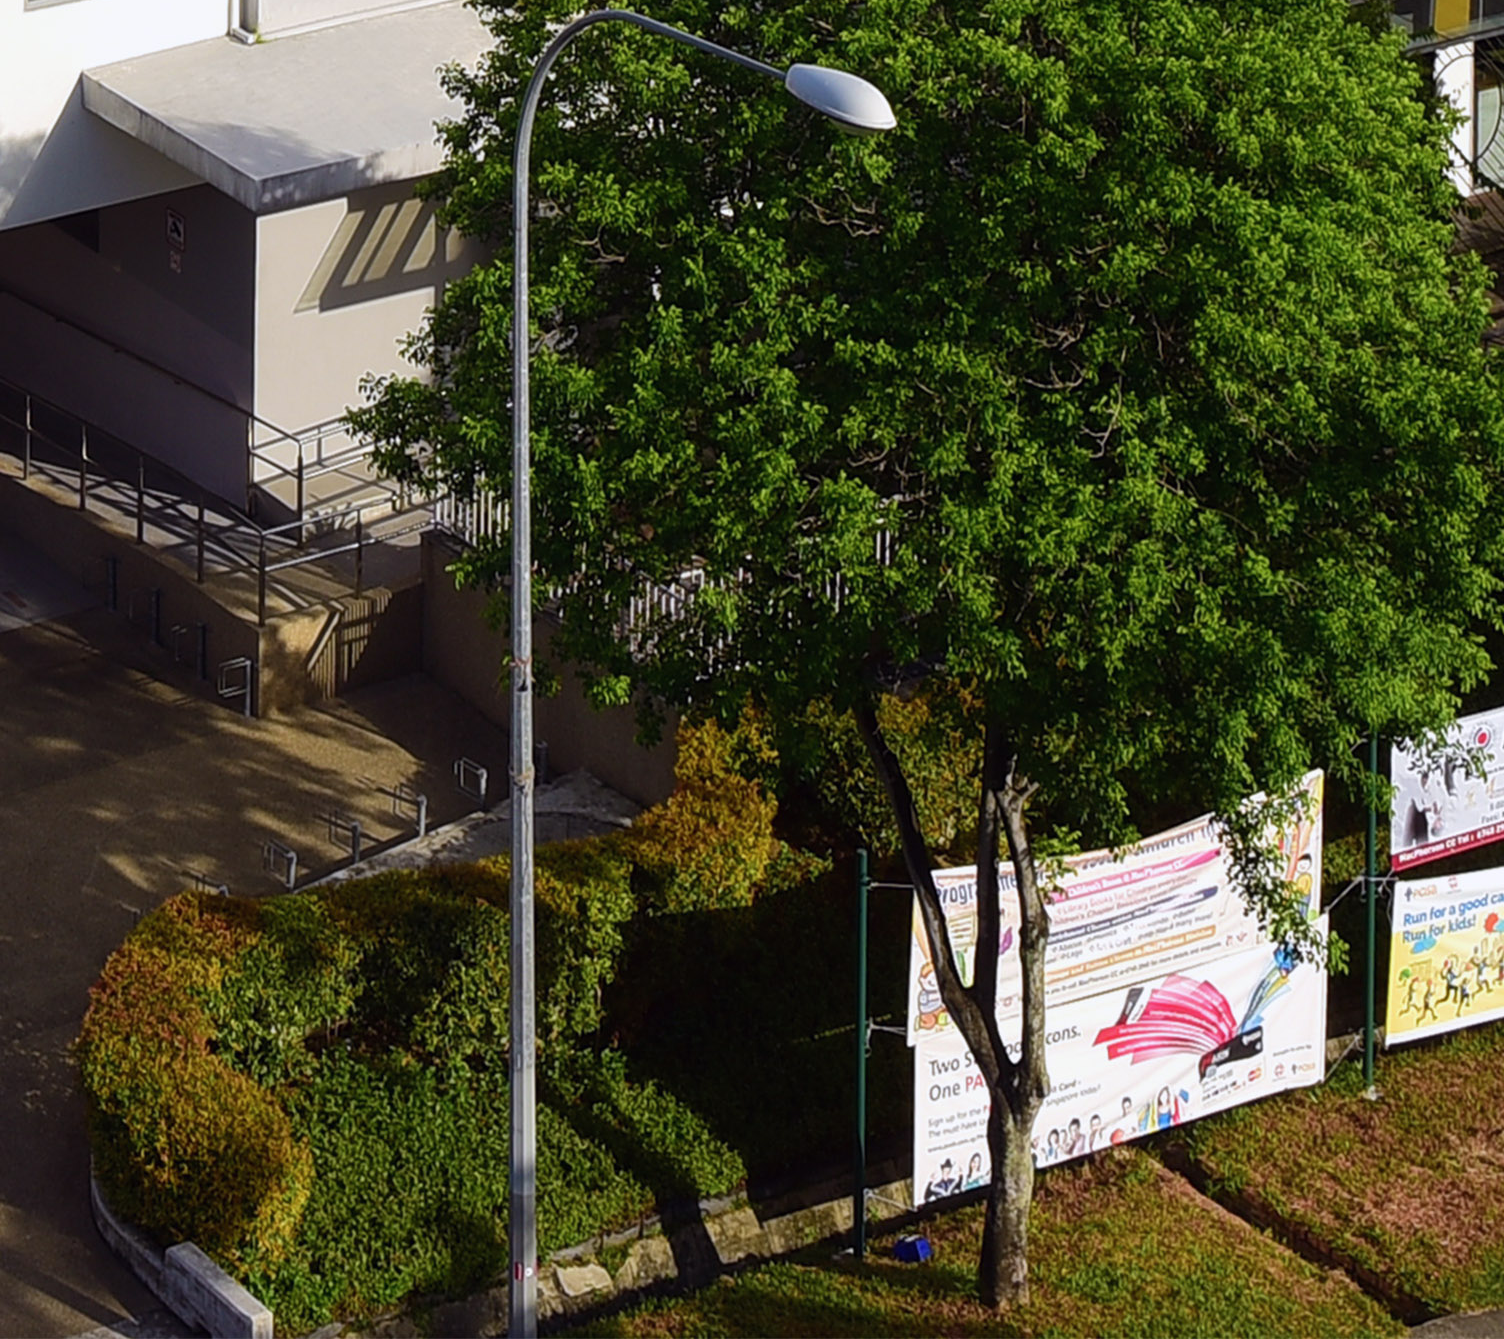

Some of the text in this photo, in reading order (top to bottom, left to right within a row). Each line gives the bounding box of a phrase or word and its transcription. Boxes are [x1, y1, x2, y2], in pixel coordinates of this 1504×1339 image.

[1398, 841, 1444, 863] MacPherson
[1445, 836, 1456, 850] CC
[1403, 911, 1427, 927] Run
[1429, 906, 1447, 921] for
[1448, 906, 1456, 915] a
[1458, 894, 1489, 916] good
[1402, 914, 1476, 944] Run for kids!
[1042, 1025, 1082, 1046] cons.
[928, 1054, 961, 1077] Two
[929, 1081, 961, 1102] One
[1059, 1078, 1077, 1092] Card
[1046, 1091, 1080, 1108] Singapore
[928, 1117, 945, 1129] Sign
[969, 1106, 981, 1117] the
[943, 1124, 959, 1135] must
[960, 1117, 977, 1131] have
